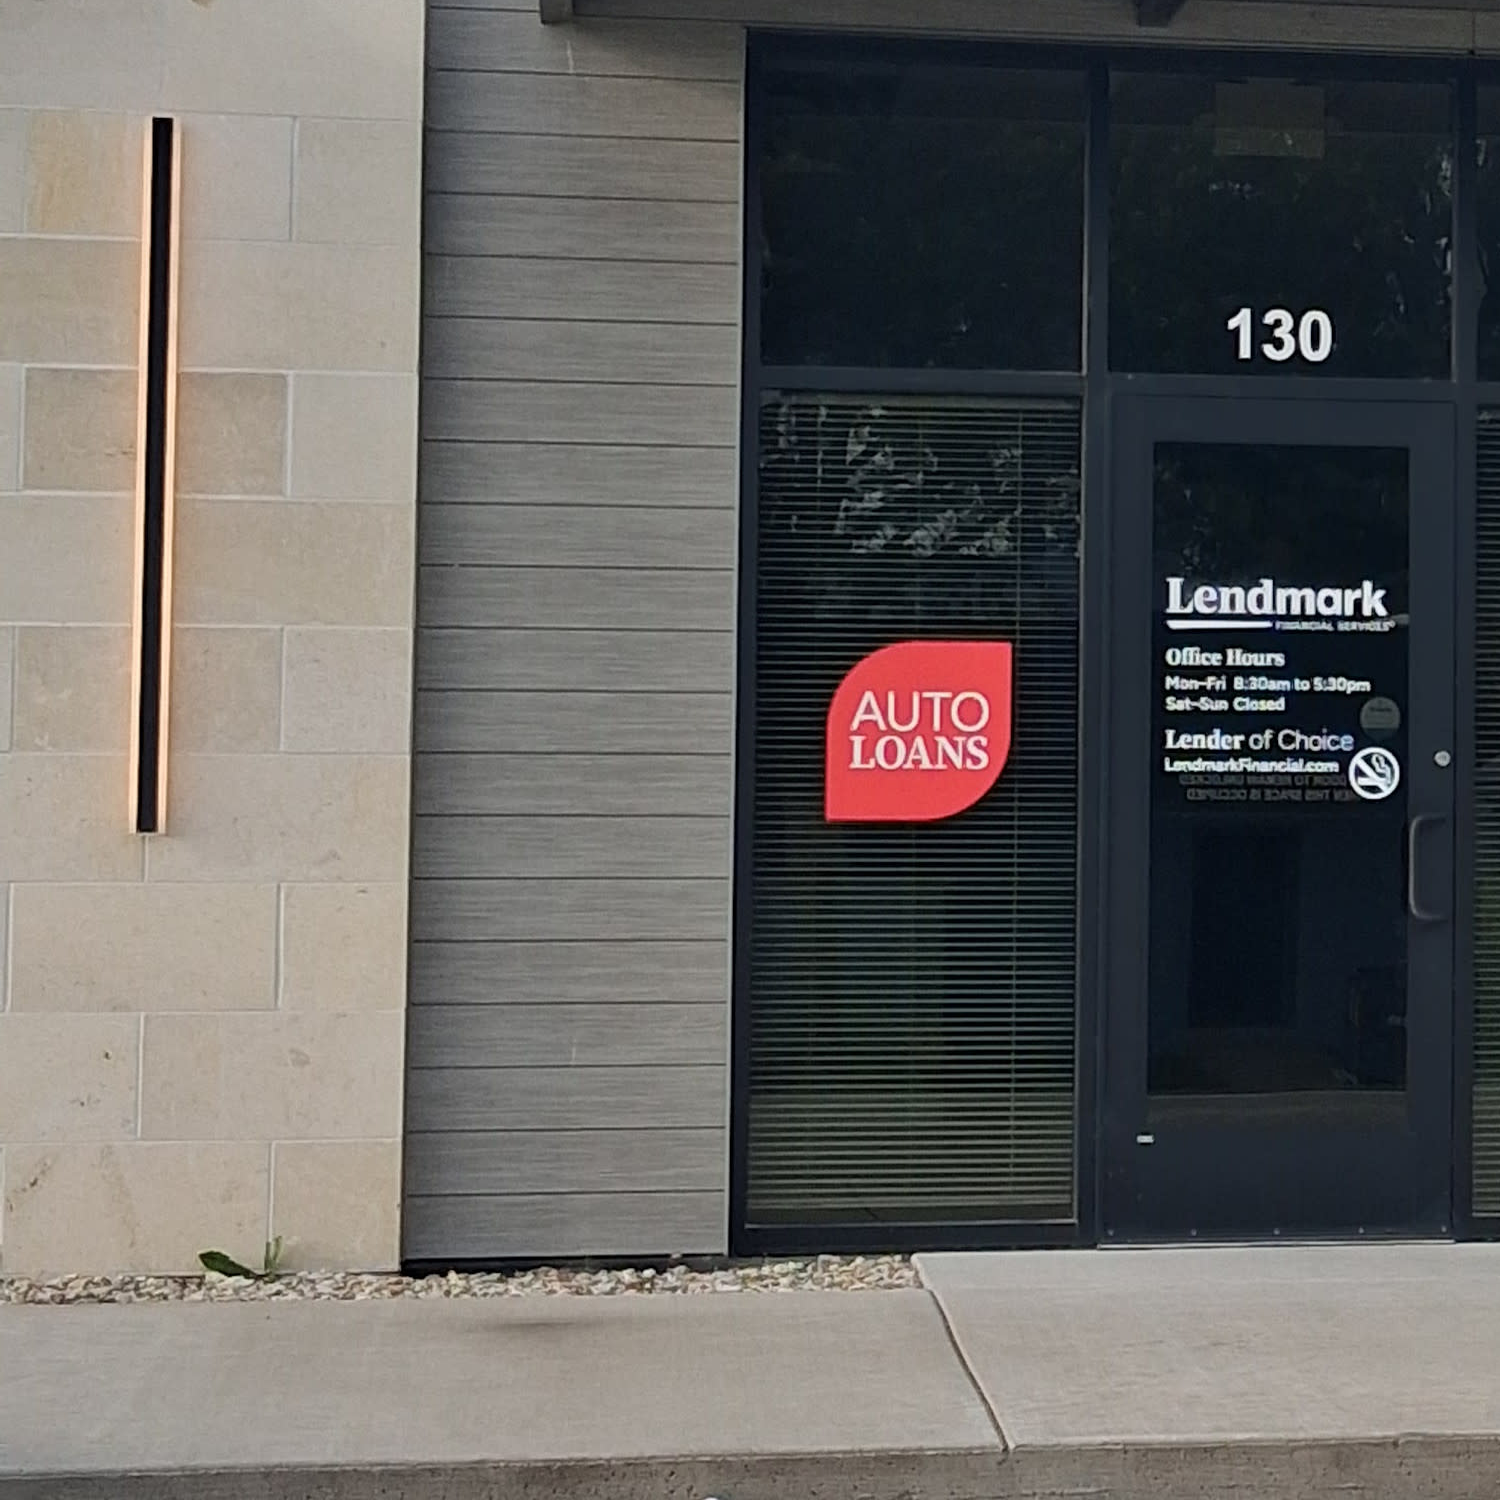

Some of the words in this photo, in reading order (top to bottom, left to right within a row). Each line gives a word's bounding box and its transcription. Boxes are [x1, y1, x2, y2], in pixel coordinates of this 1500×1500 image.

[1227, 307, 1333, 362] 130
[1165, 577, 1388, 617] Lendmark
[1165, 647, 1223, 667] Office
[1225, 648, 1286, 668] Hours
[1165, 675, 1227, 691] Mon-Fri
[1233, 676, 1291, 692] 8:30am
[1294, 677, 1310, 691] to
[1313, 677, 1371, 694] 5:30pm
[850, 690, 990, 733] AUTO
[1165, 696, 1229, 712] Sat-Sun
[1233, 697, 1286, 712] Closed
[1165, 729, 1245, 750] Lender
[1248, 729, 1274, 750] of
[1277, 729, 1355, 751] Choice
[848, 735, 989, 771] LOANS
[1164, 757, 1340, 773] LendmarkFinancial.com
